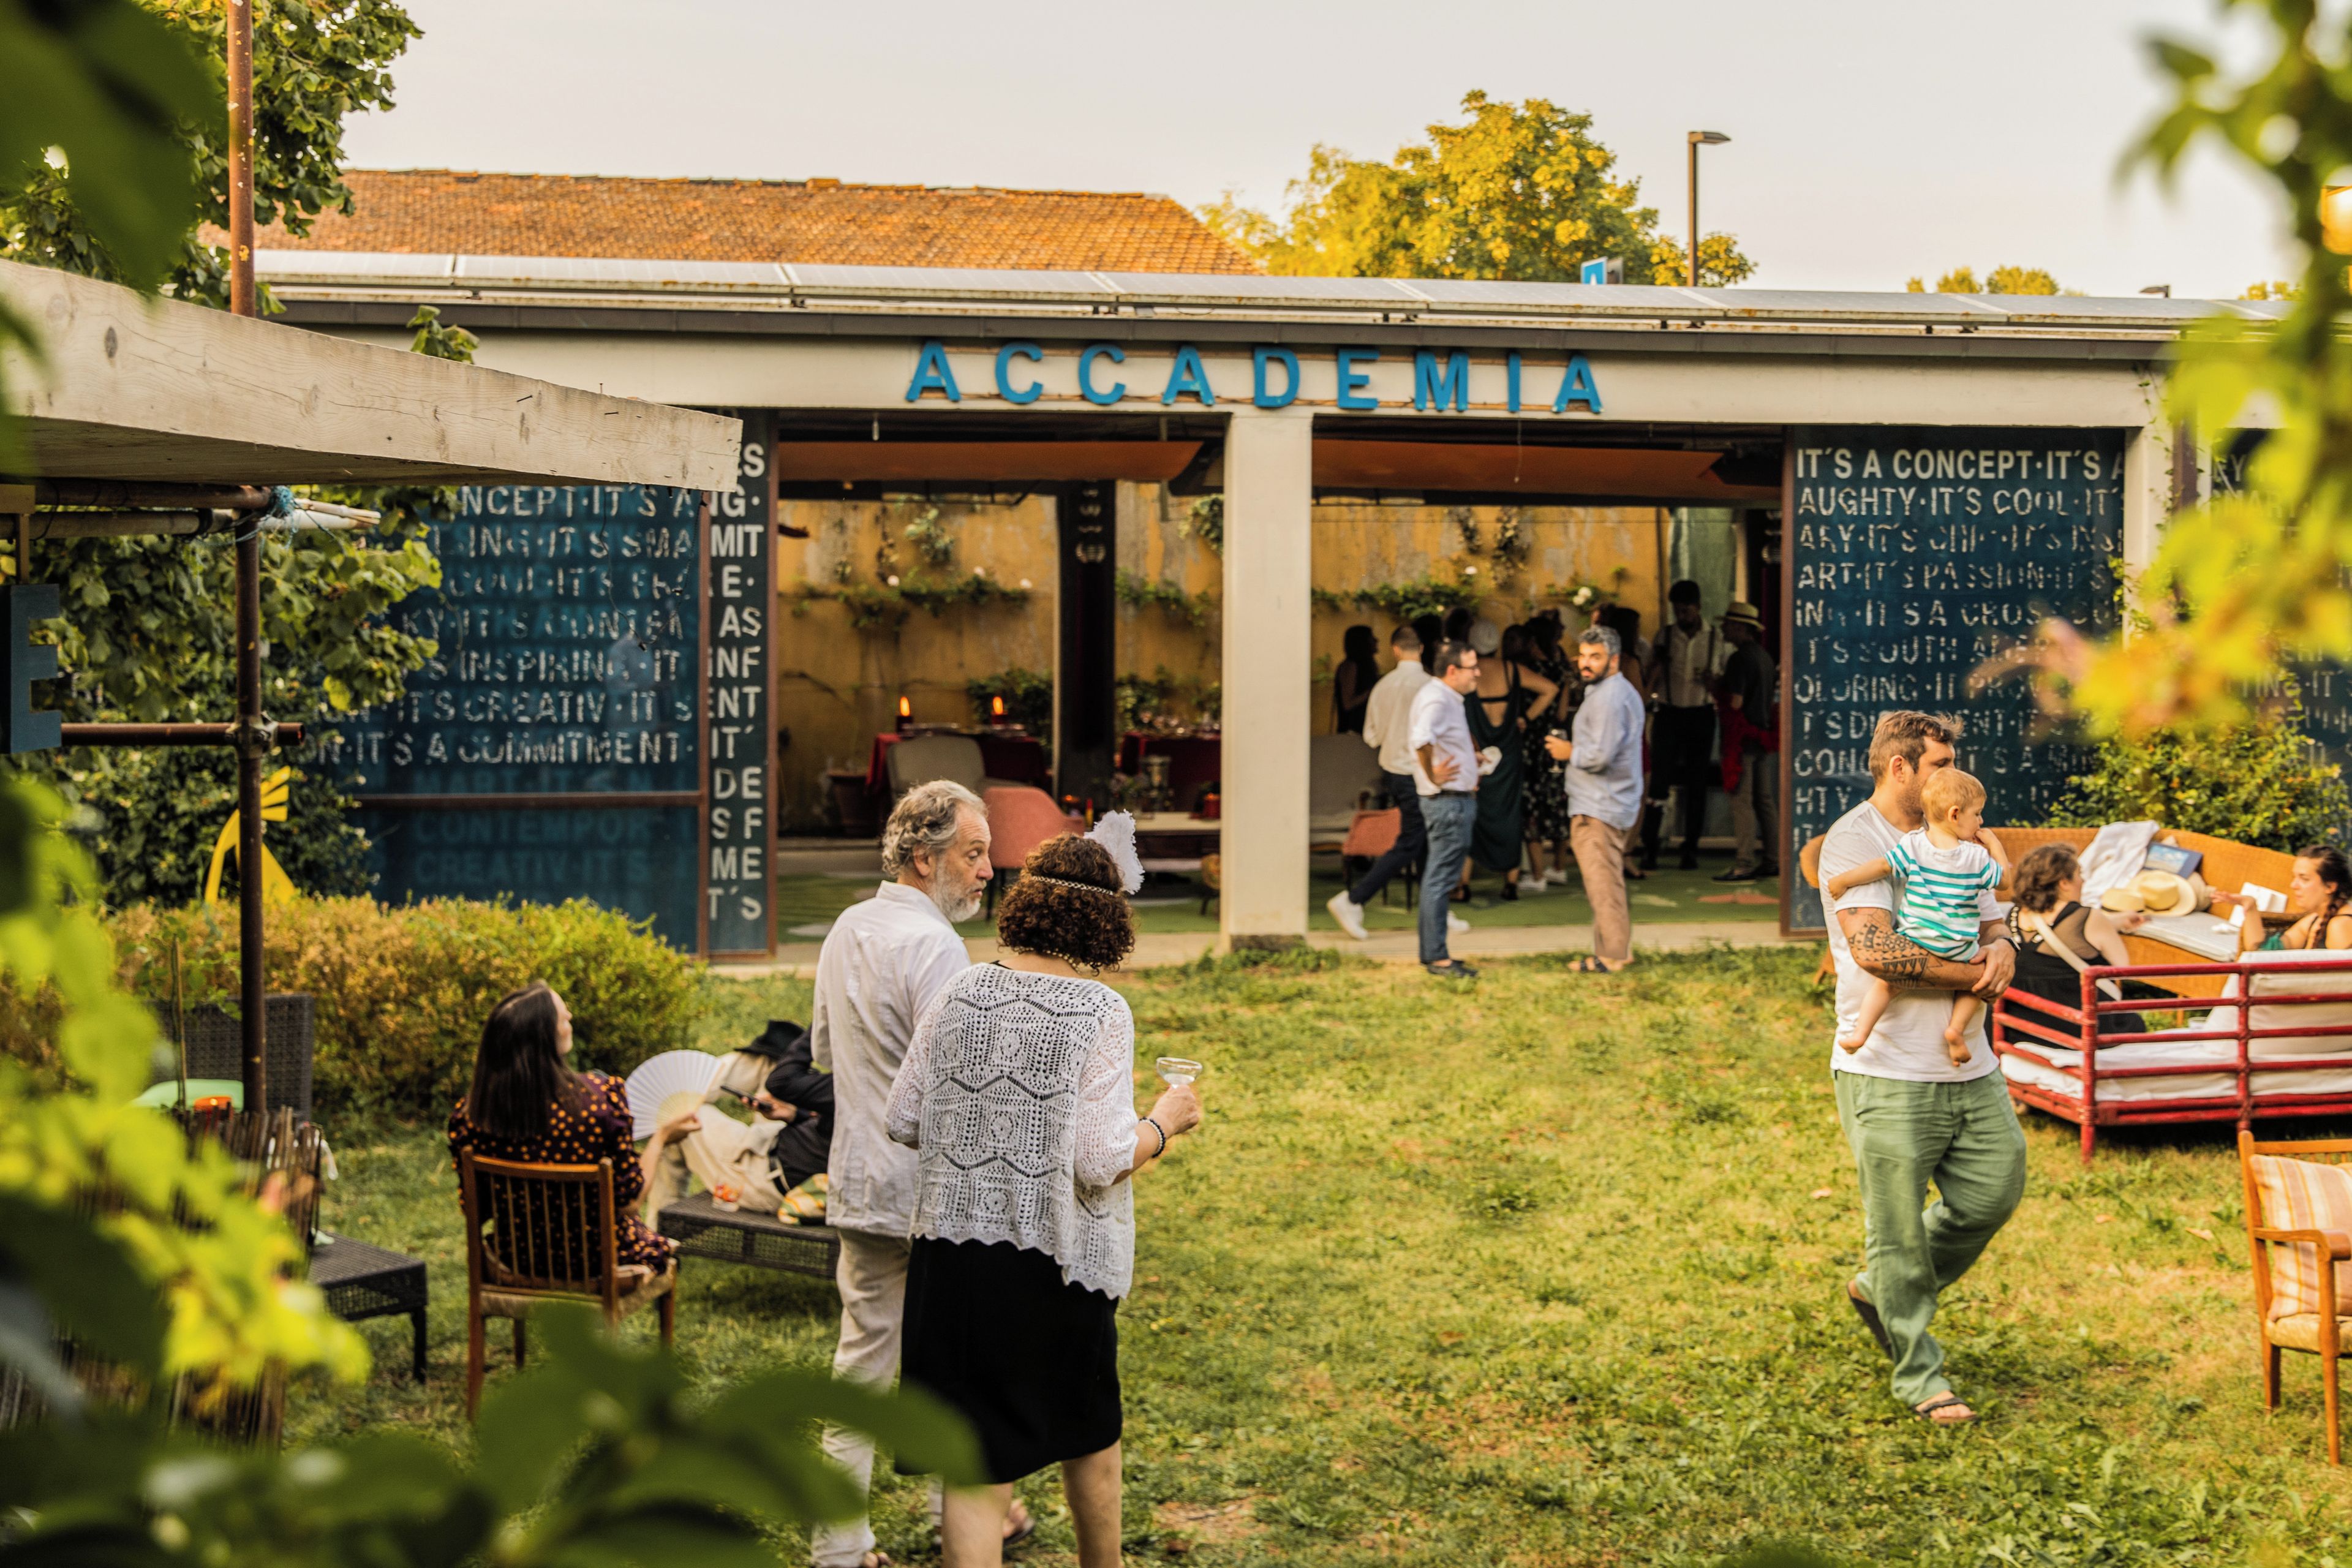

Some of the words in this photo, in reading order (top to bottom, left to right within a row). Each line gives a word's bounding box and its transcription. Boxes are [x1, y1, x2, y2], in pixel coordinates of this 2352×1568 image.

[905, 339, 1606, 415] ACCADEMIA
[1797, 448, 1852, 480] IT'S
[1862, 449, 1883, 478] A
[1893, 448, 2033, 480] CONCEPT
[2046, 450, 2101, 480] IT'S
[1798, 486, 1917, 516] AUGHTY
[1931, 486, 1982, 516] IT'S
[1798, 561, 1855, 590] ART
